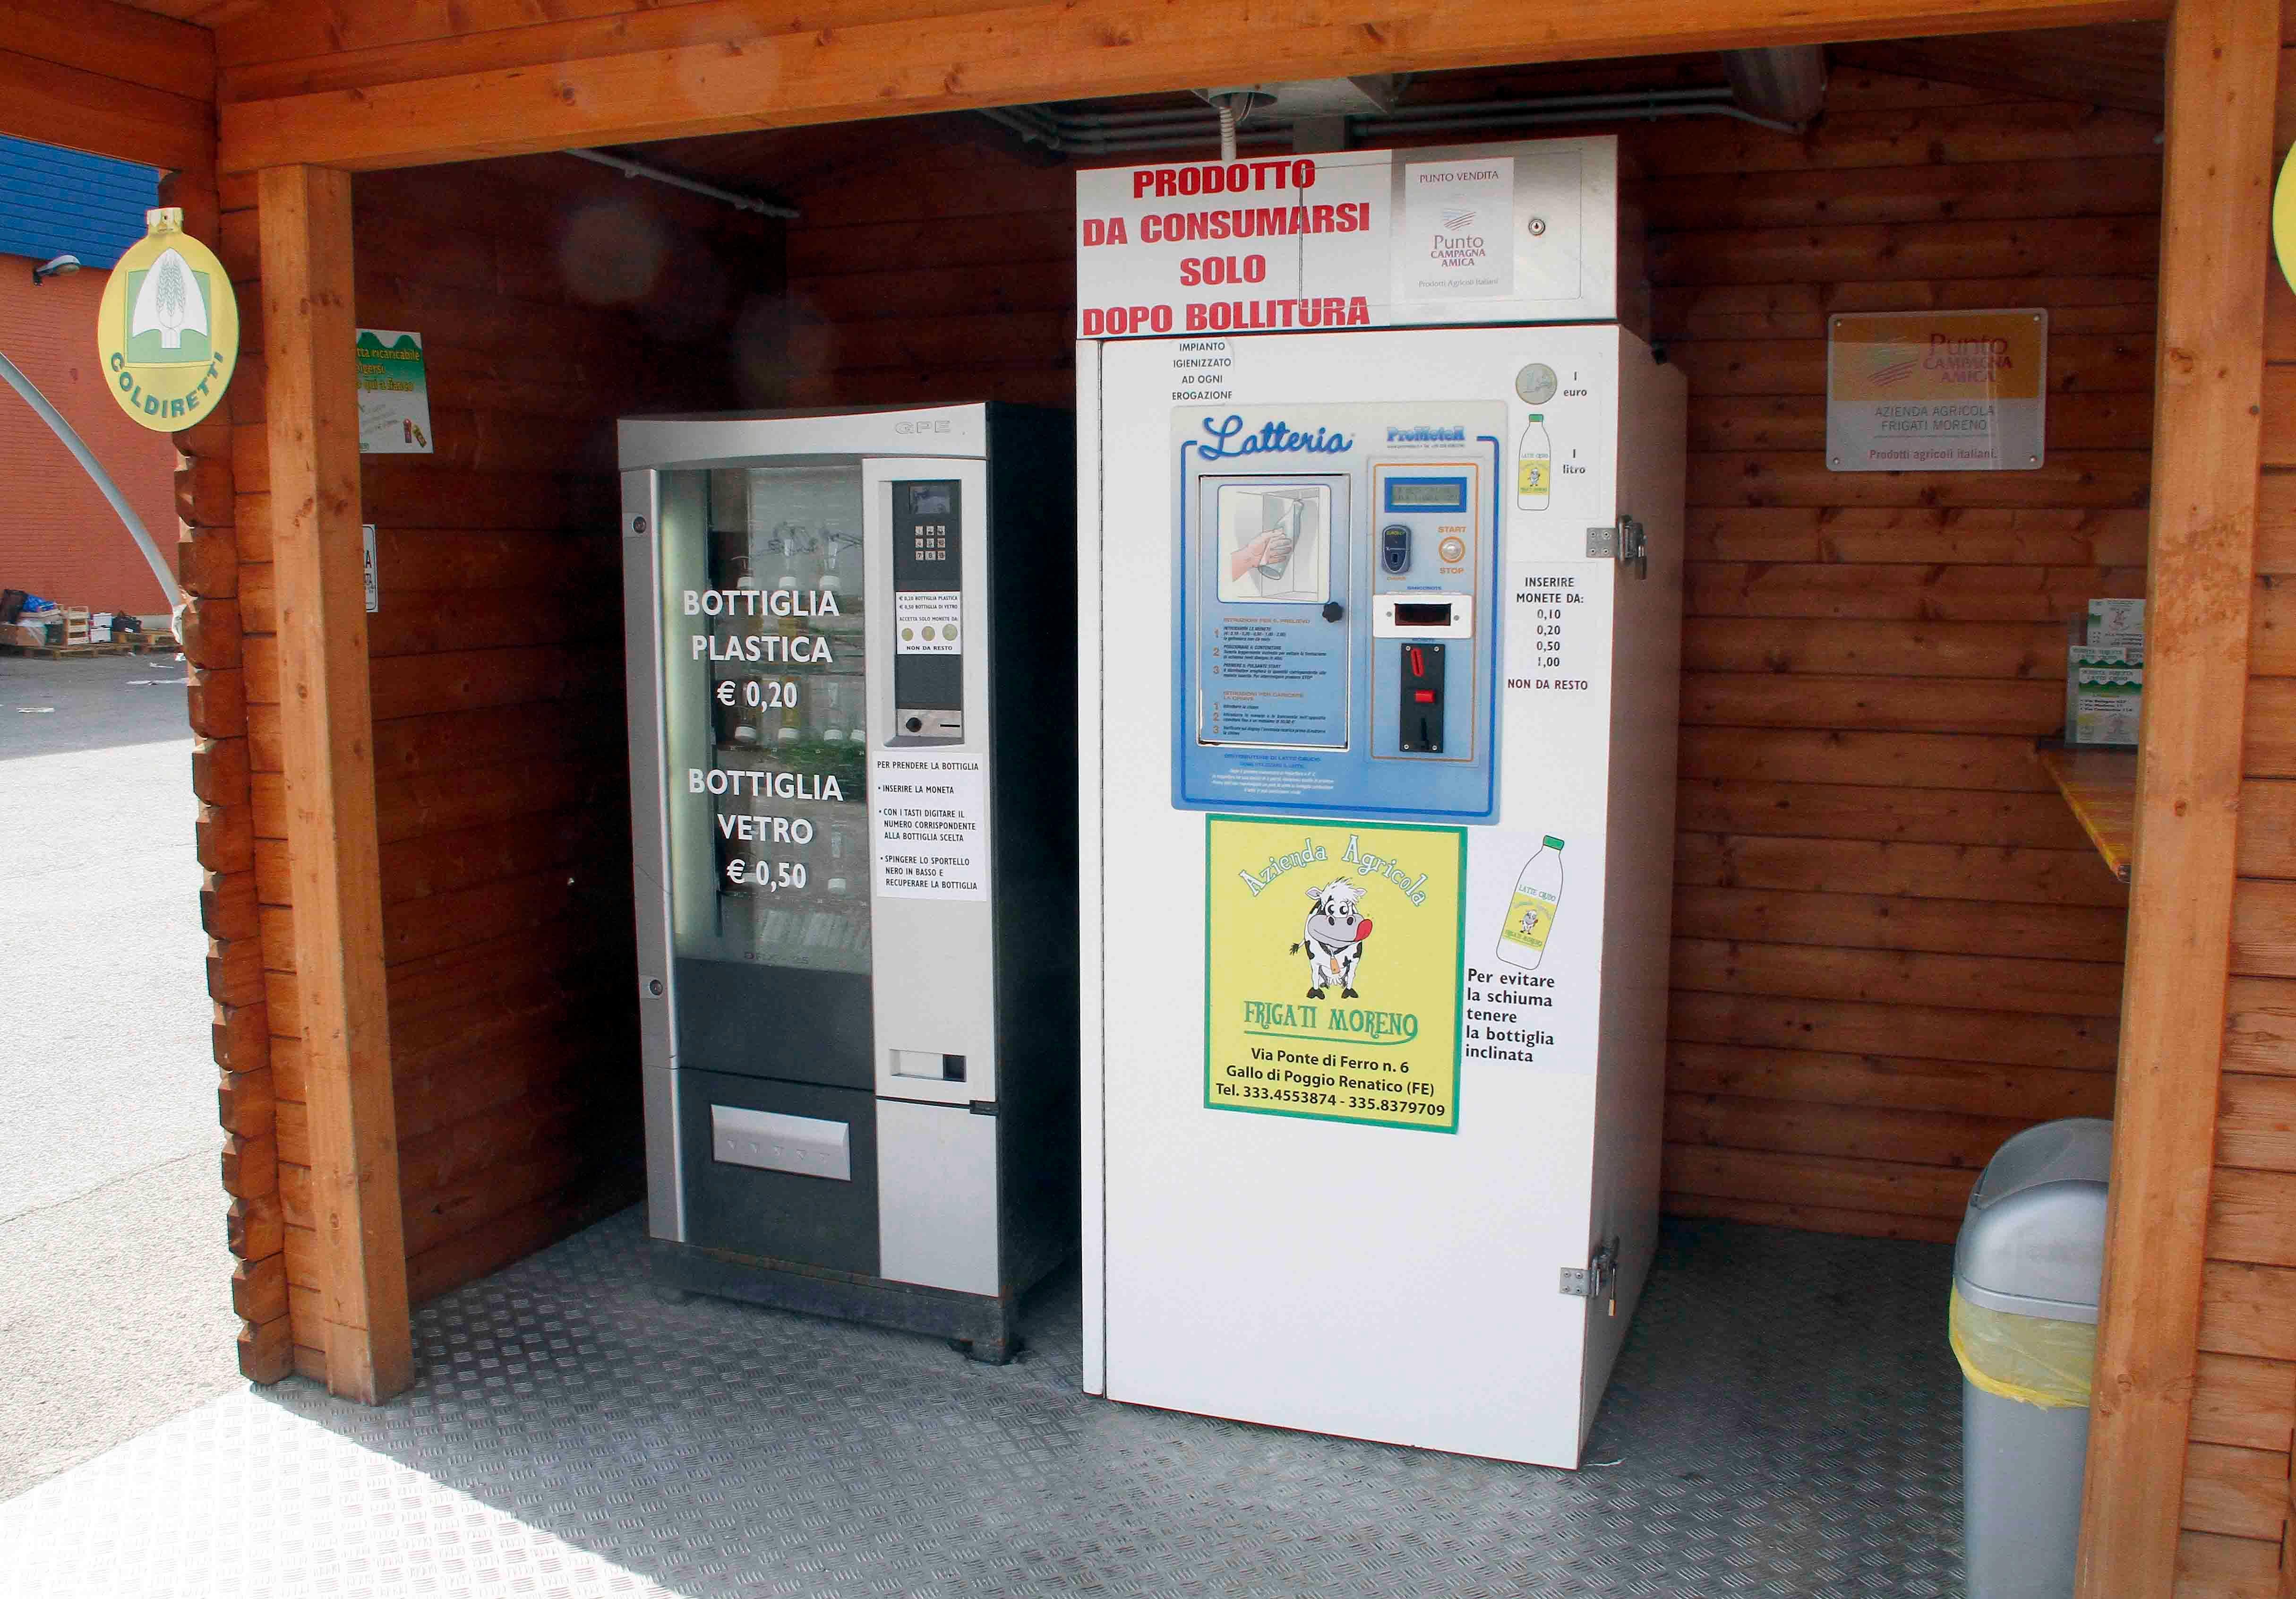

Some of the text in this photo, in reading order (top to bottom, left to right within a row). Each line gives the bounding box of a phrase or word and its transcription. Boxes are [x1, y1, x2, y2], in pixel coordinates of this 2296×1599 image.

[1134, 159, 1316, 198] PRODOTTO
[1419, 170, 1499, 183] PUNTO VENDITA
[1083, 203, 1370, 247] DA CONSUMARSI
[1433, 235, 1484, 250] Punto
[1430, 248, 1486, 258] CAMPAGNA
[1441, 258, 1475, 267] AMICA
[1180, 254, 1266, 286] SOLO
[1083, 296, 1371, 335] DOPO BOLLITURA
[1179, 342, 1225, 352] IMPIANTO
[1173, 358, 1232, 368] IGIENIZZATO
[110, 351, 224, 419] COLDIRETTI
[1182, 374, 1223, 384] AD OGNI
[1563, 388, 1587, 397] euro
[1874, 404, 1995, 417] AZIENDA AGRICOLA
[1198, 414, 1354, 461] Latteria
[1869, 449, 1910, 459] Prodotti
[1912, 448, 1953, 461] agricoli
[1563, 464, 1586, 474] litro
[1525, 577, 1575, 587] INSERIRE
[683, 590, 840, 617] BOTTIGLIA
[1516, 593, 1584, 603] MONETE DA:
[1537, 609, 1561, 620] 0,10
[1536, 625, 1561, 636] 0,20
[691, 635, 833, 663] PLASTICA
[1536, 641, 1560, 652] 0,50
[1538, 657, 1560, 668] 1,00
[1508, 679, 1588, 690] NON DA RESTO
[717, 680, 798, 712] € 0,20
[892, 761, 928, 770] PRENDERE
[942, 763, 979, 771] BOTTIGLIA
[688, 768, 844, 802] BOTTIGLIA
[882, 784, 913, 793] INSERIRE
[926, 786, 954, 794] MONETA
[904, 809, 922, 817] TASTI
[925, 810, 956, 818] DIGITARE
[717, 813, 814, 844] VETRO
[884, 820, 976, 830] NUMERO CORRISPONDENTE
[884, 832, 964, 842] ALLA BOTTIGLIA SCELTA
[885, 855, 970, 866] SPINGERE LO SPORTELLO
[727, 859, 806, 893] € 0,50
[885, 867, 903, 875] NERO
[916, 868, 936, 877] BASSO
[1238, 834, 1430, 907] Azienda Agricola
[886, 878, 977, 890] RECUPERARE LA BOTTIGLIA
[1467, 968, 1555, 988] Per evitare
[1467, 987, 1553, 1007] la schiuma
[1243, 1000, 1418, 1040] FRIGATI MORENO
[1466, 1007, 1517, 1023] tenere
[1466, 1024, 1554, 1048] la bottiglia
[1465, 1044, 1534, 1062] inclinata
[1251, 1047, 1410, 1074] Via Ponte di Ferro n. 6
[1226, 1065, 1435, 1098] Gallo di Poggio Renatico (FE)
[1216, 1083, 1240, 1097] Tel.
[1243, 1085, 1337, 1107] 333.4553874
[1348, 1096, 1446, 1117] 335.8379709
